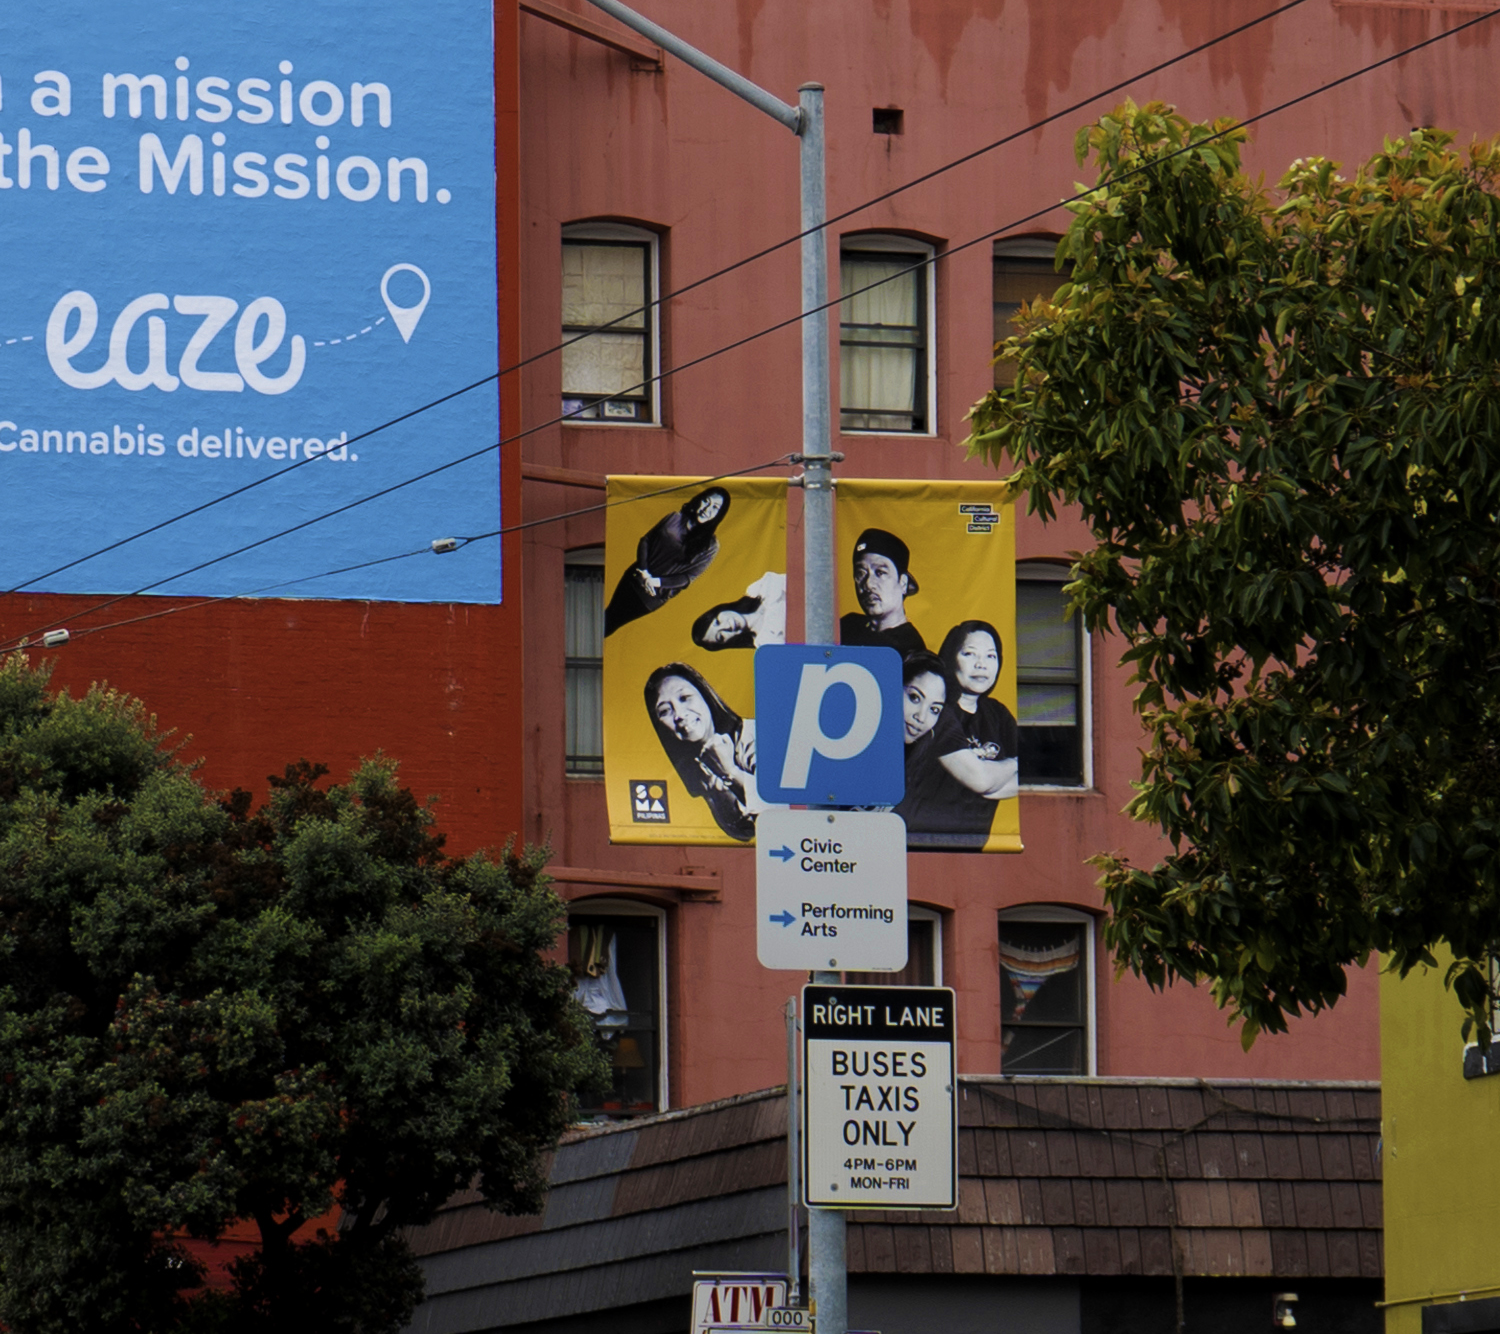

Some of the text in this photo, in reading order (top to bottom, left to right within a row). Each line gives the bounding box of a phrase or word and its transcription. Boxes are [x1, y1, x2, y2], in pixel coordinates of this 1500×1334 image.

[31, 70, 72, 117] a
[102, 55, 393, 129] mission
[137, 131, 452, 205] Mission.
[45, 289, 307, 396] eaze
[176, 427, 359, 463] delivered.
[800, 837, 843, 854] Civic
[800, 856, 858, 873] Center
[801, 902, 894, 924] Performing
[800, 921, 838, 937] Arts
[813, 1004, 945, 1027] RIGHT LANE
[832, 1050, 927, 1078] BUSES
[840, 1085, 920, 1113] TAXIS
[843, 1119, 917, 1146] ONLY
[843, 1158, 918, 1172] 4PM-6PM
[850, 1176, 910, 1190] MON-FRI
[700, 1286, 777, 1324] ATM
